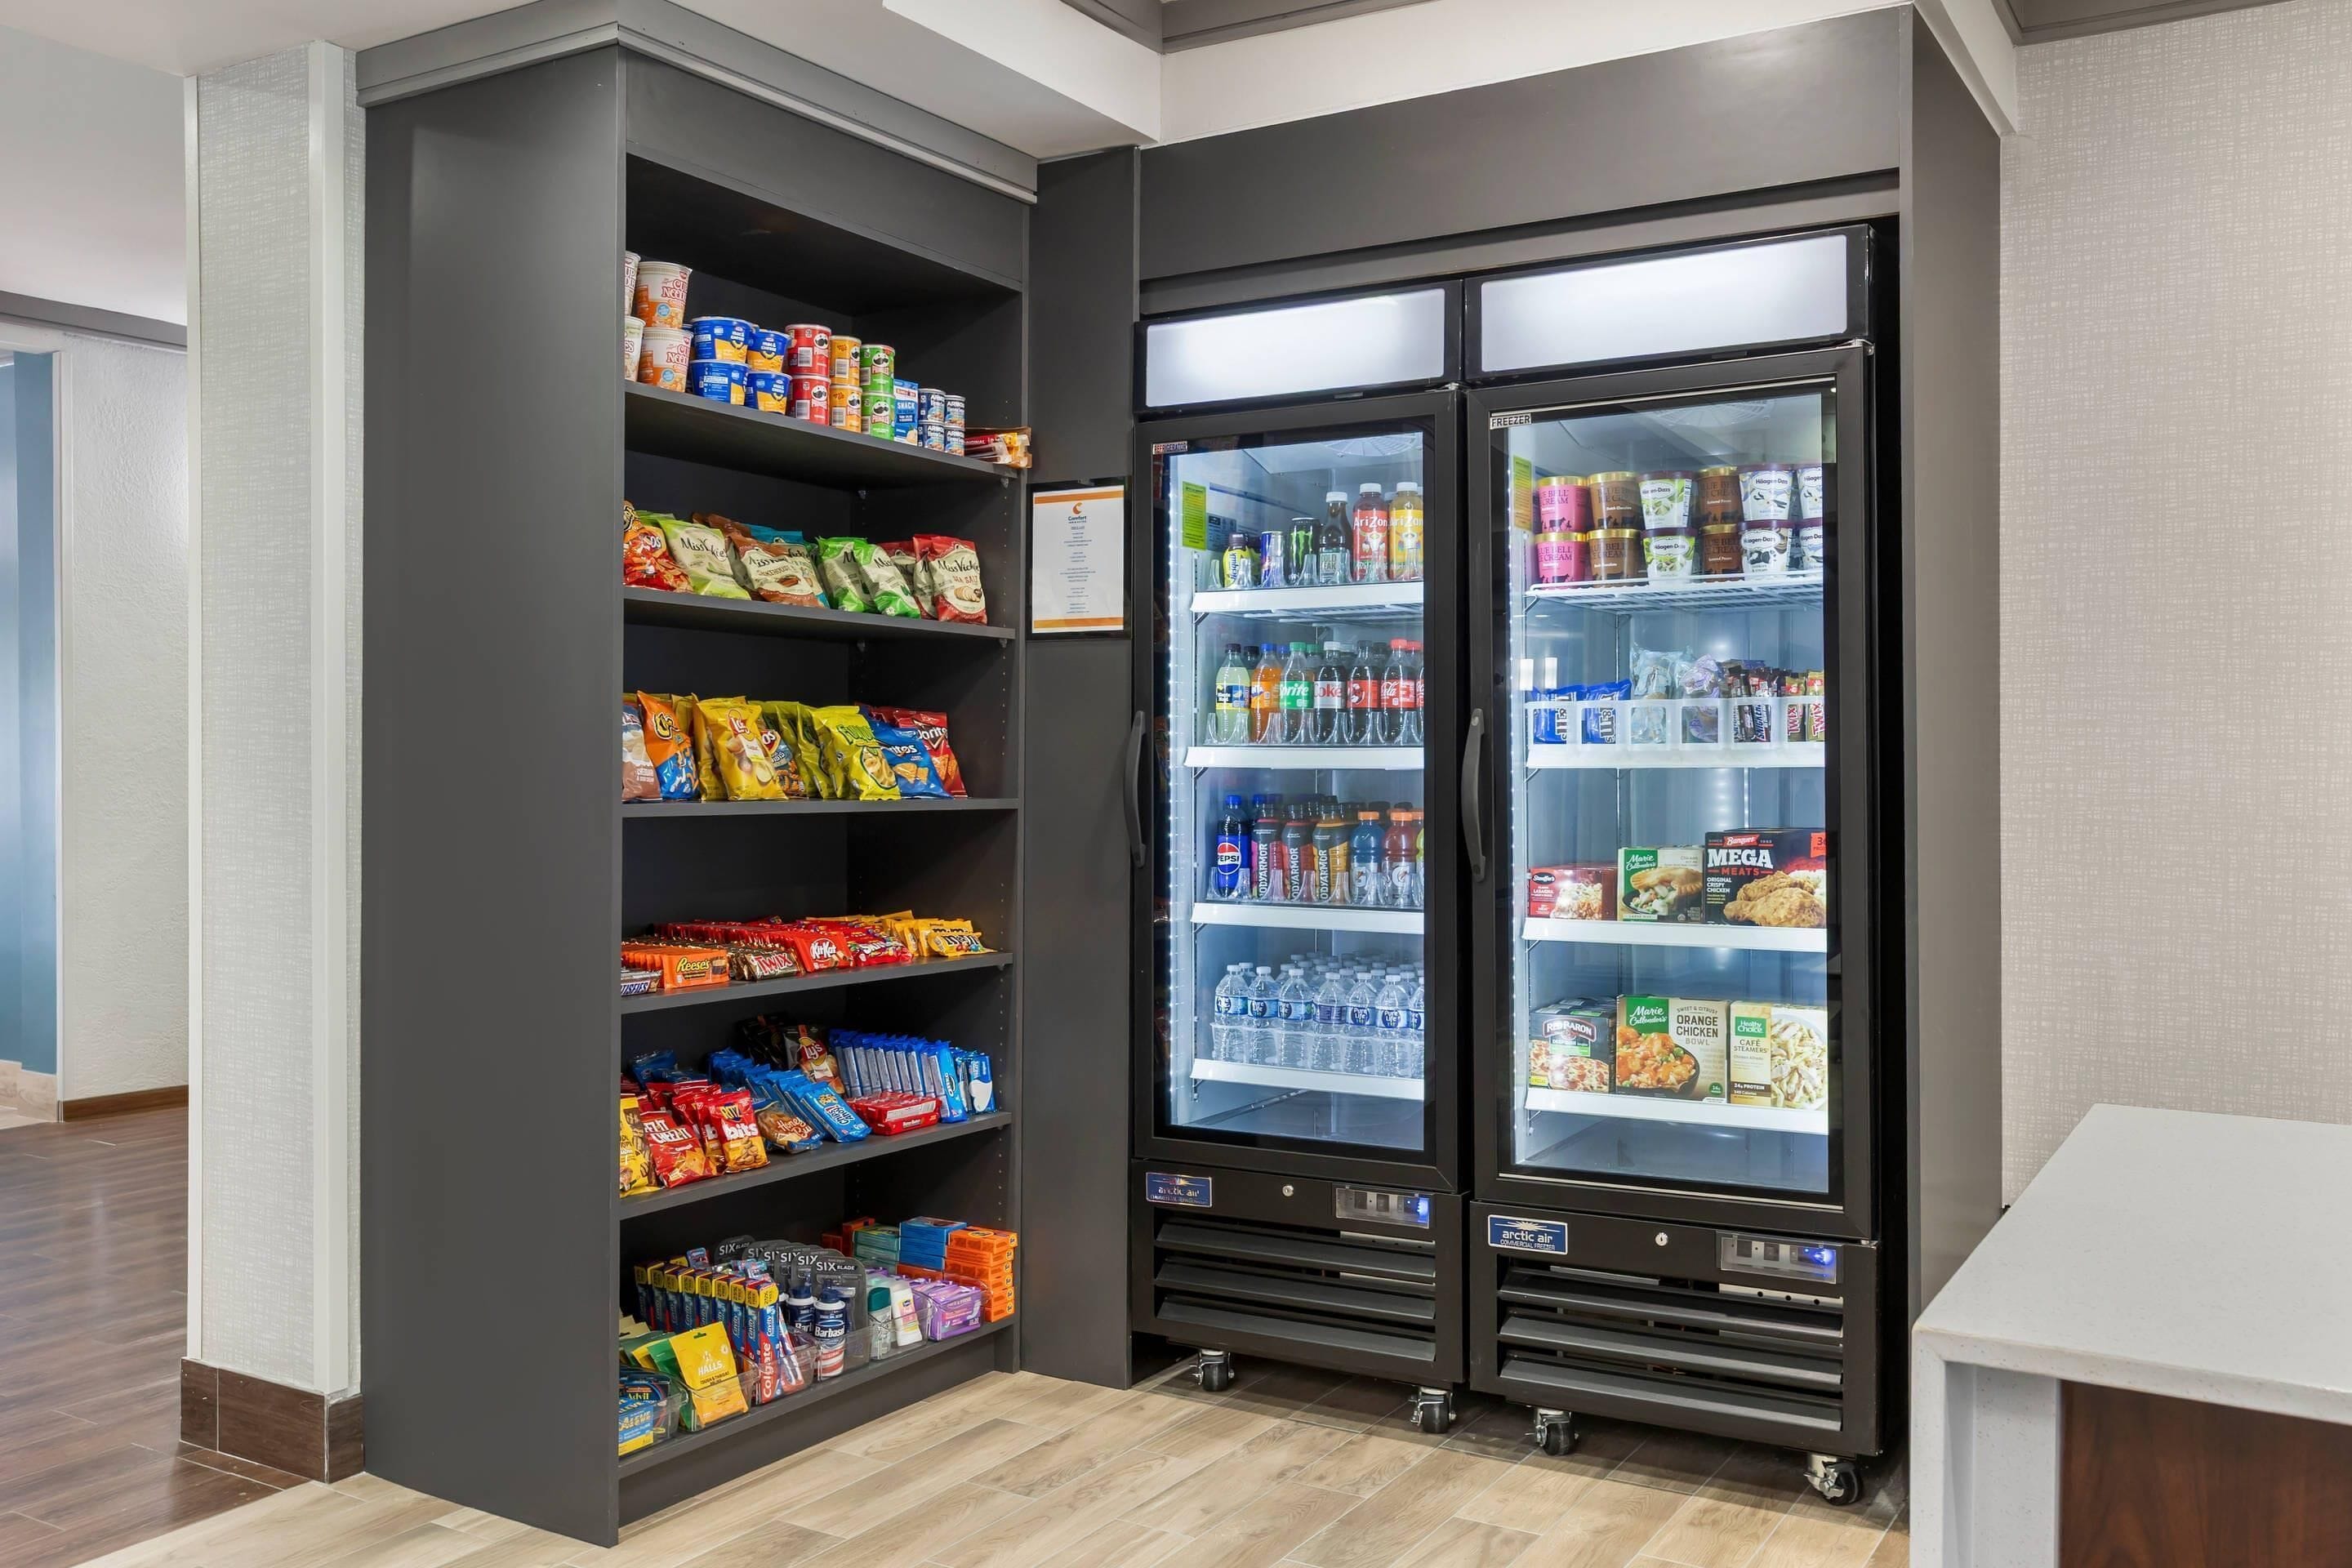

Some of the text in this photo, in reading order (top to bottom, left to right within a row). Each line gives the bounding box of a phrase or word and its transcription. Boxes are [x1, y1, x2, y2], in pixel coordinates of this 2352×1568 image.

[1491, 415, 1530, 427] FREEZER
[1353, 515, 1388, 530] AriZon
[938, 559, 956, 572] Miss
[1788, 707, 1800, 736] TWIX
[889, 744, 918, 755] ritos
[1726, 836, 1757, 845] Banquet
[1628, 854, 1655, 865] Marie
[1707, 849, 1774, 870] MEGA
[1290, 847, 1300, 899] ODYARMOR
[1319, 849, 1329, 899] ODYARMOR
[1721, 868, 1760, 876] MEATS
[675, 956, 711, 973] Reese's
[754, 952, 792, 975] TWIX
[1629, 1005, 1664, 1018] Marie
[1629, 1016, 1668, 1027] Callender's
[1676, 1014, 1719, 1027] ORANGE
[1740, 1019, 1762, 1028] Healthy
[1546, 1020, 1592, 1036] RED BARON
[1676, 1026, 1719, 1038] CHICKEN
[1737, 1026, 1763, 1034] Choice
[1685, 1037, 1710, 1046] BOWL
[1740, 1038, 1761, 1047] CAFÉ
[1734, 1045, 1767, 1054] STEAMERS
[719, 1104, 742, 1120] RITZ
[653, 1127, 693, 1143] CHEEZ-IT
[722, 1118, 759, 1141] bits
[1158, 1186, 1200, 1197] arctic air
[1502, 1231, 1553, 1244] arctic air
[719, 1242, 736, 1256] SIX
[1499, 1239, 1556, 1251] COMMERCIAL FREEZER
[748, 1247, 764, 1258] SI
[764, 1250, 780, 1262] SI
[817, 1261, 837, 1272] SIX
[697, 1361, 724, 1376] HALLS
[763, 1343, 774, 1398] Colgate
